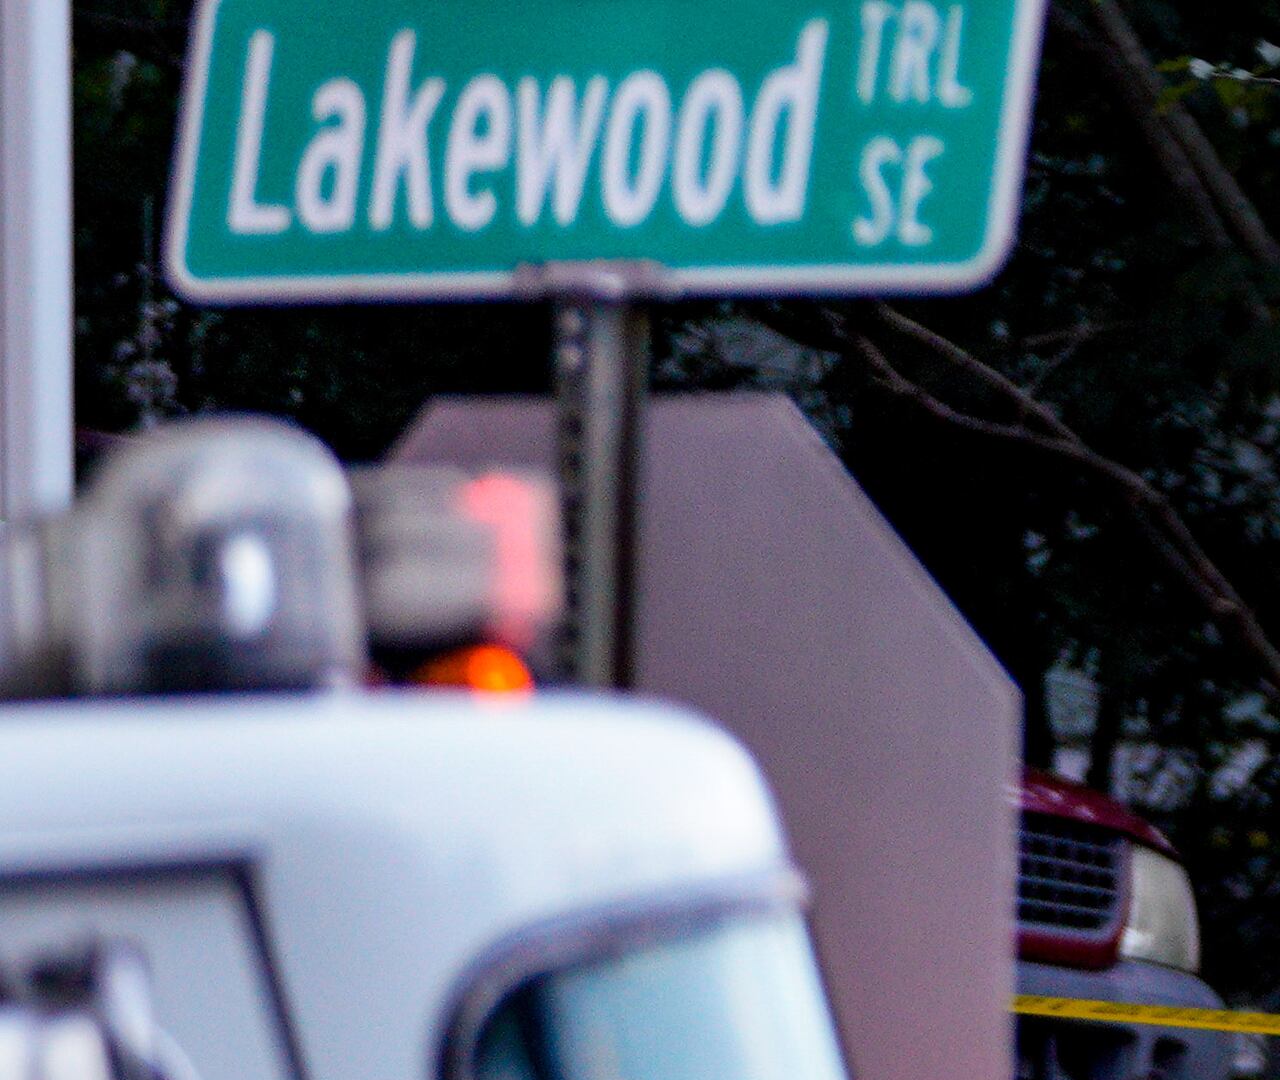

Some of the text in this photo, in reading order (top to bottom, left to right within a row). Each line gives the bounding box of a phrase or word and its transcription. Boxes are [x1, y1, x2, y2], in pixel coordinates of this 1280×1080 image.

[856, 0, 973, 108] TRL
[225, 18, 830, 235] Lakewood
[853, 134, 945, 246] SE
